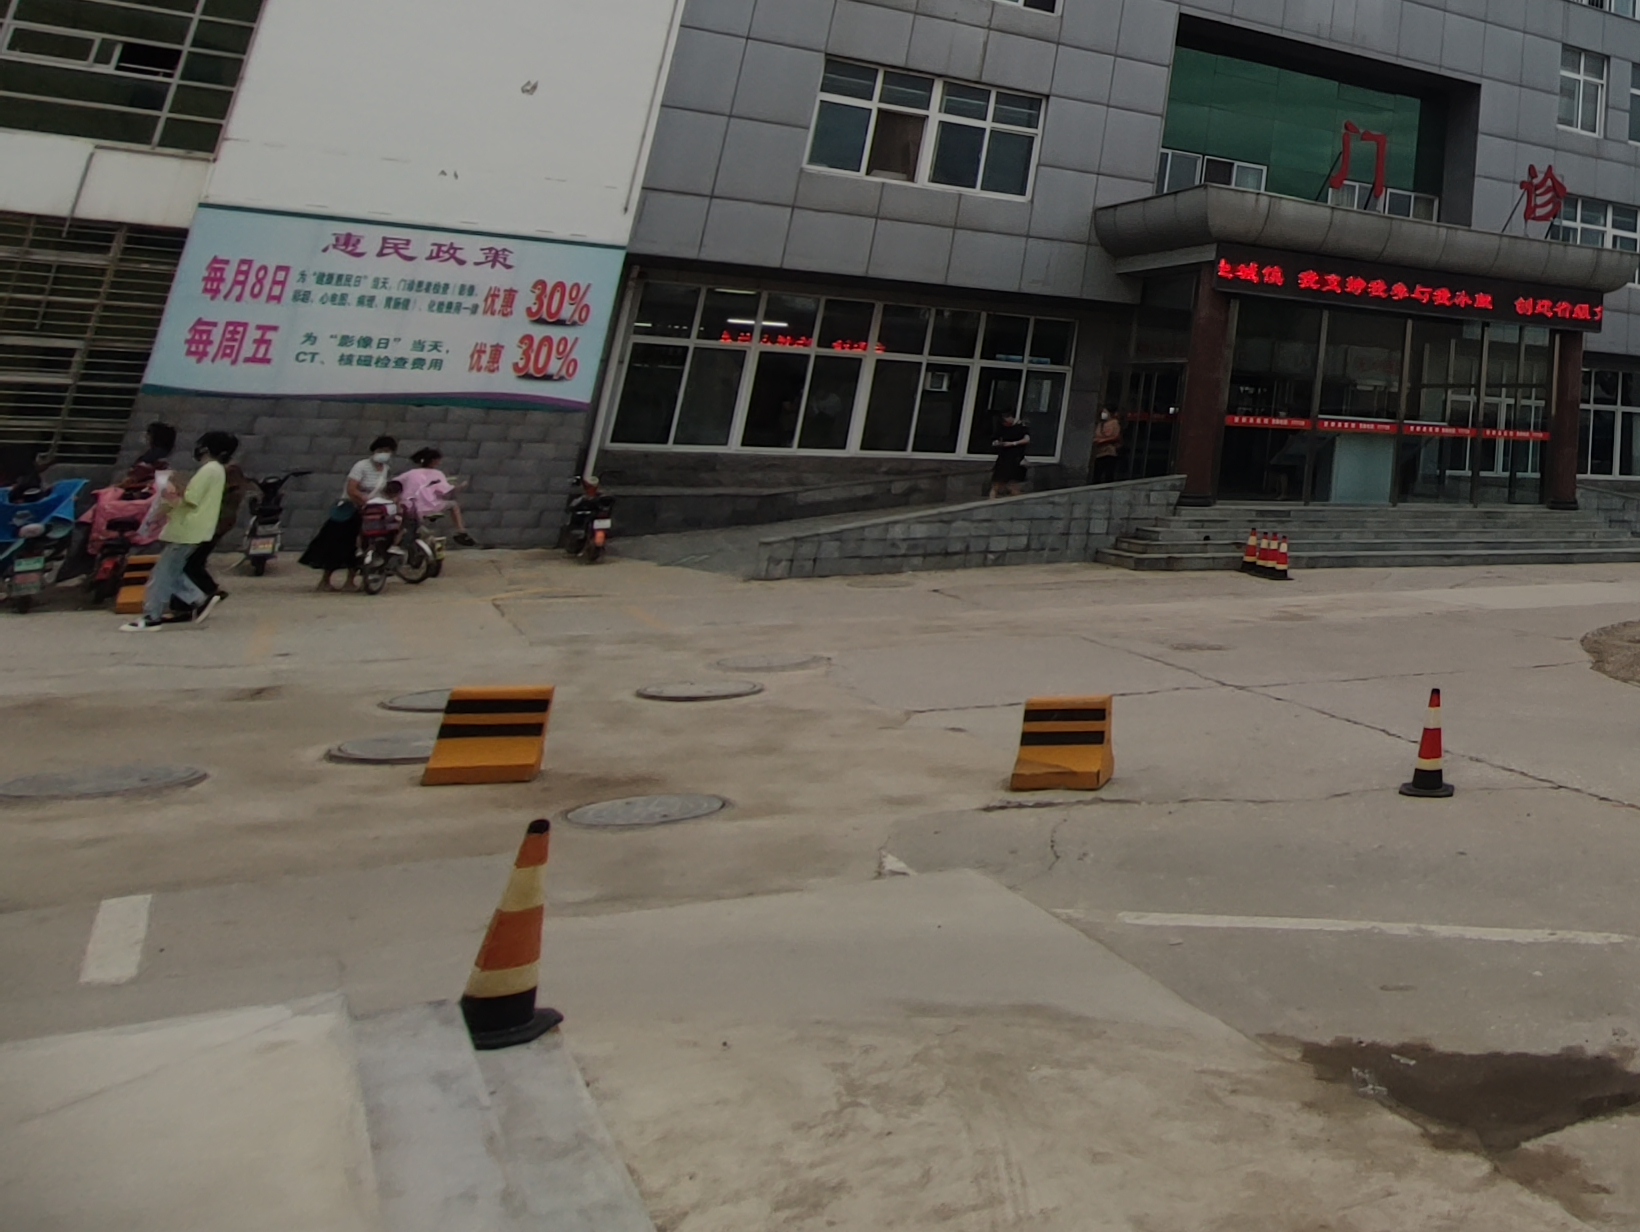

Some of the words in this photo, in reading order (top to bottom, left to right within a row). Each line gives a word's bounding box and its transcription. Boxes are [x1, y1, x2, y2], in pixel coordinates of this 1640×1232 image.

[321, 231, 516, 269] 惠民政策
[202, 254, 291, 305] 每月8日
[482, 284, 518, 318] 优惠
[525, 278, 592, 325] 30%
[184, 316, 280, 366] 每周五
[468, 341, 505, 375] 优惠
[511, 333, 580, 380] 30%
